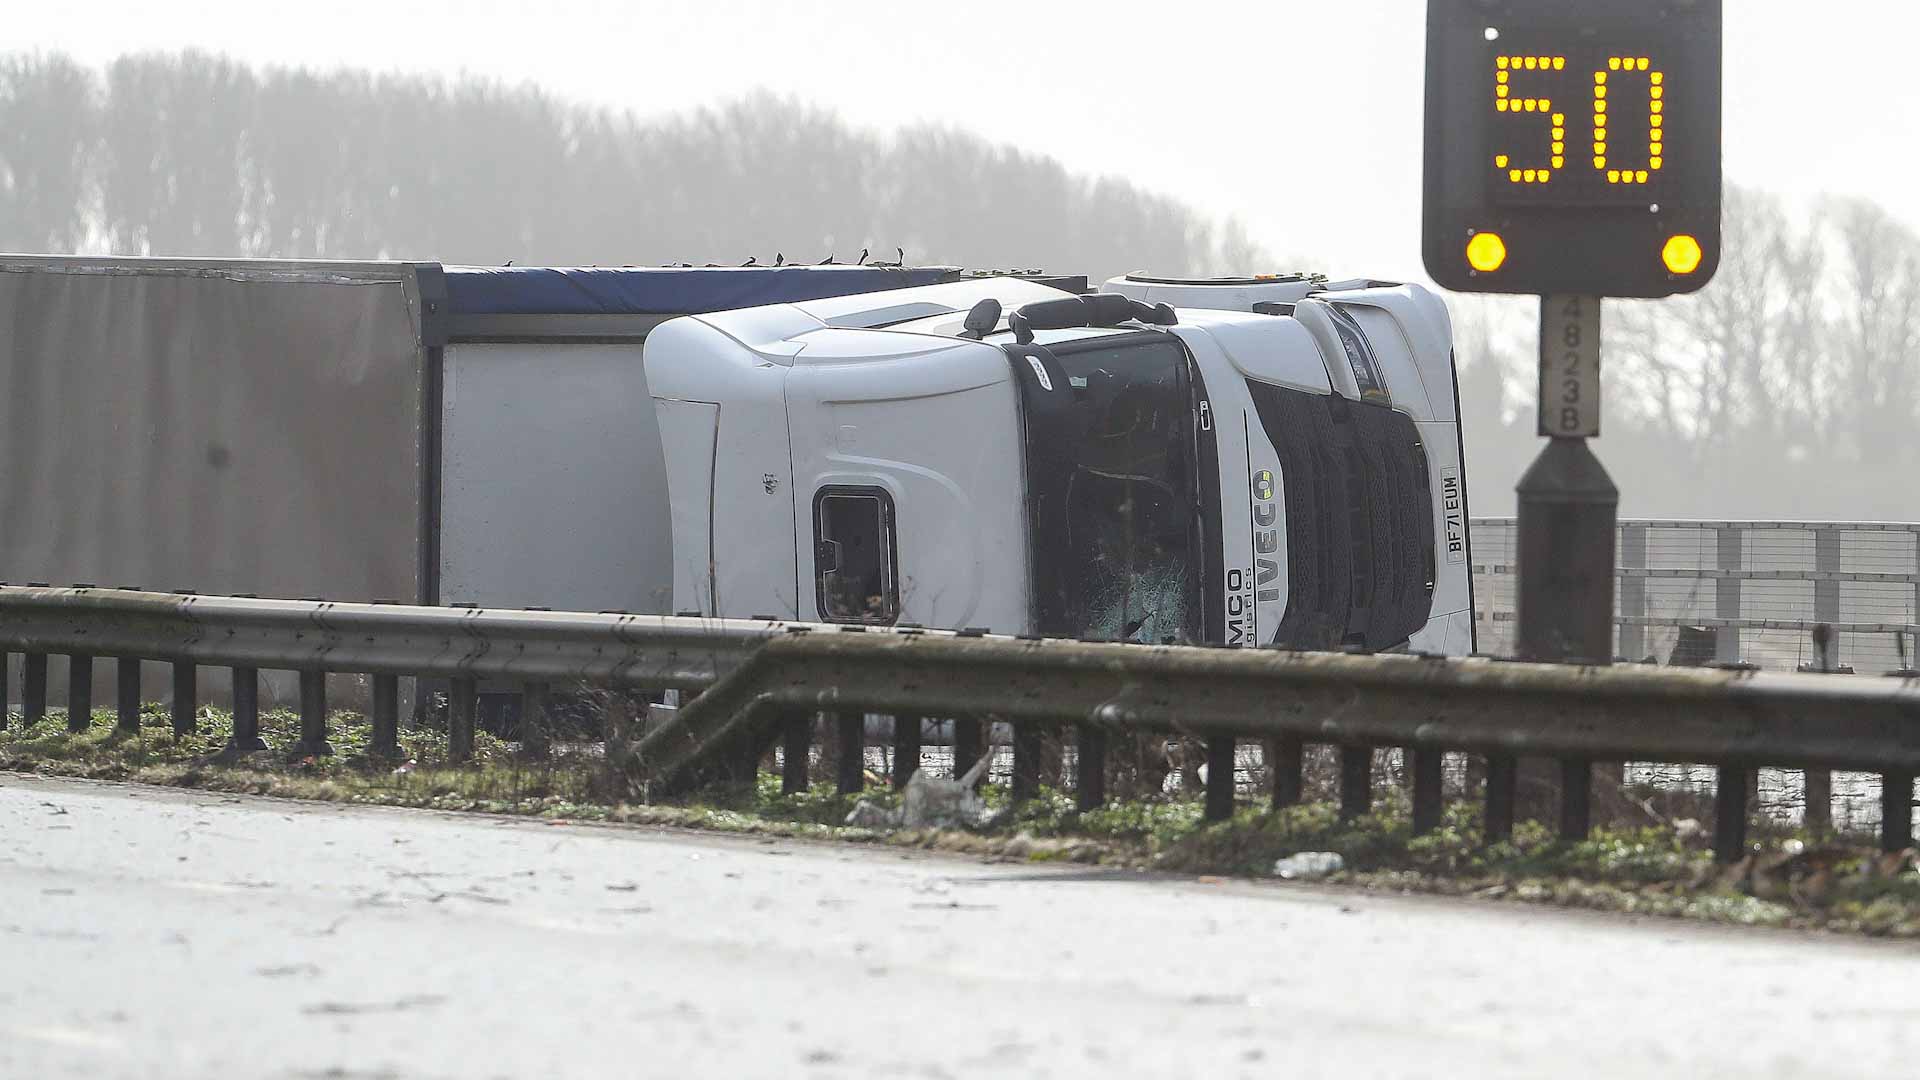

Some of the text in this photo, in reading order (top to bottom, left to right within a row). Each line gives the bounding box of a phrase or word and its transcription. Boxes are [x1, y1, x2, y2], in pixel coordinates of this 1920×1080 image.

[1495, 55, 1664, 185] 50
[1253, 469, 1279, 602] IVECO
[1443, 477, 1462, 553] BF71 EUM
